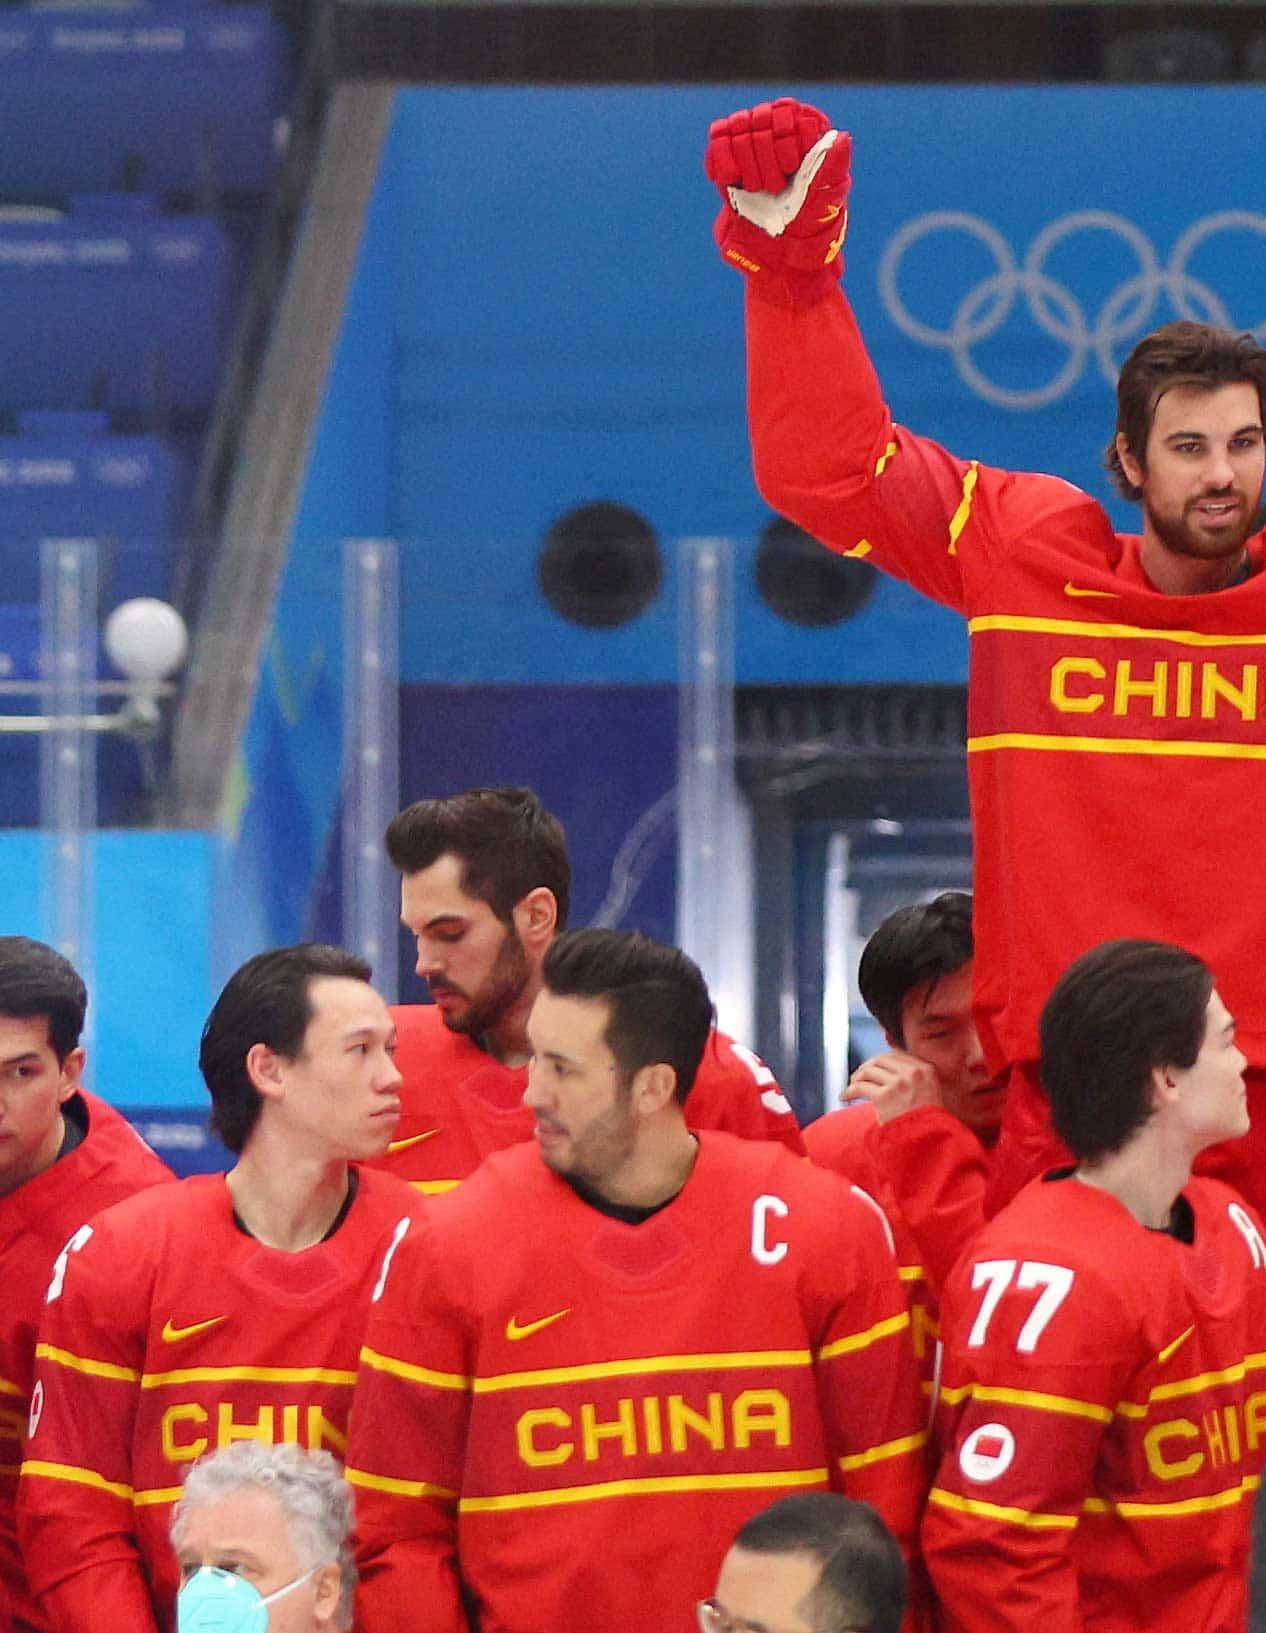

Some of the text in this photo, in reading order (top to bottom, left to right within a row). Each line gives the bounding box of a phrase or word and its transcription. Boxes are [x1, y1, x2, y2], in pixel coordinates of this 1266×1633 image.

[751, 1194, 789, 1265] C
[968, 1259, 1075, 1354] 77
[516, 1389, 791, 1468] CHINA
